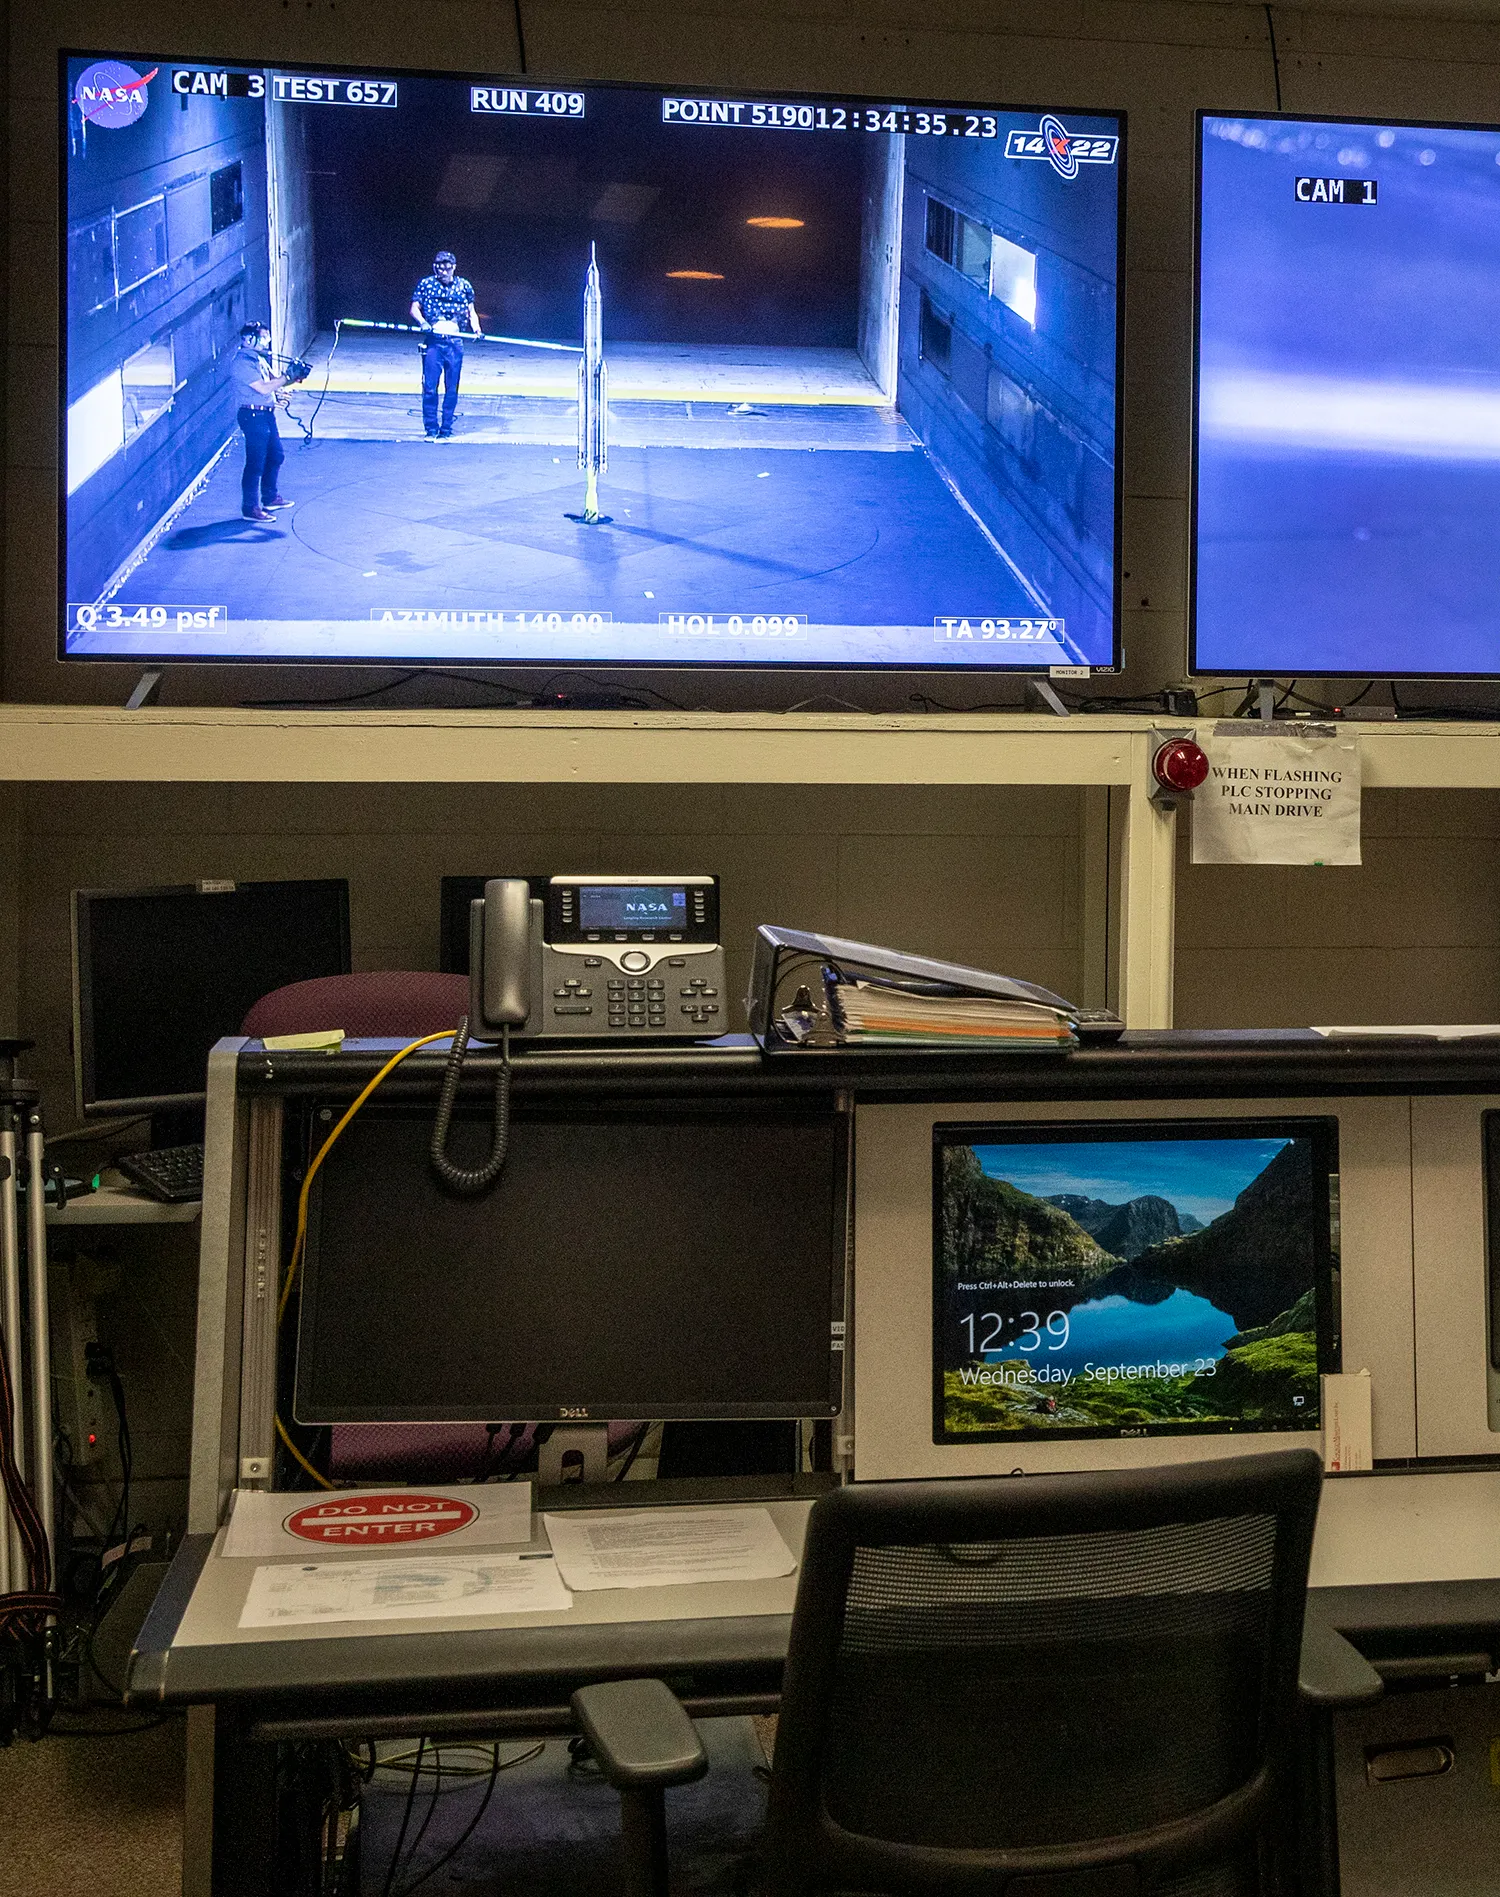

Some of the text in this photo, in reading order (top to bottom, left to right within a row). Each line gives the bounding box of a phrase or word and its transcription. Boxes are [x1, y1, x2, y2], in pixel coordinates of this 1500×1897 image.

[82, 86, 144, 104] NASA
[173, 71, 265, 98] CAM 3
[274, 79, 396, 104] TEST 657
[473, 90, 583, 114] RUN 409
[663, 100, 812, 128] POINT 5190
[816, 108, 997, 137] 12:34:35.23
[1297, 178, 1376, 204] CAM 1
[76, 606, 219, 632] Q 3.49 psf
[380, 612, 604, 634] AZIMUTH 140.00
[668, 615, 799, 637] HOL 0.099
[941, 618, 974, 639] TA
[1212, 767, 1342, 783] WHEN FLASHING
[1221, 785, 1332, 800] PLC STOPPING
[1229, 803, 1323, 818] MAIN DRIVE
[626, 903, 668, 911] NASA
[958, 1282, 977, 1290] Press
[979, 1280, 1037, 1290] Ctrl+Alt+Delete
[1049, 1279, 1075, 1287] unlock.
[960, 1310, 1070, 1353] 12:39
[960, 1358, 1217, 1387] Wednesday, September 23
[560, 1407, 588, 1418] DELL
[1121, 1428, 1148, 1437] DELL
[317, 1502, 451, 1517] DO NOT
[323, 1522, 437, 1536] ENTER
